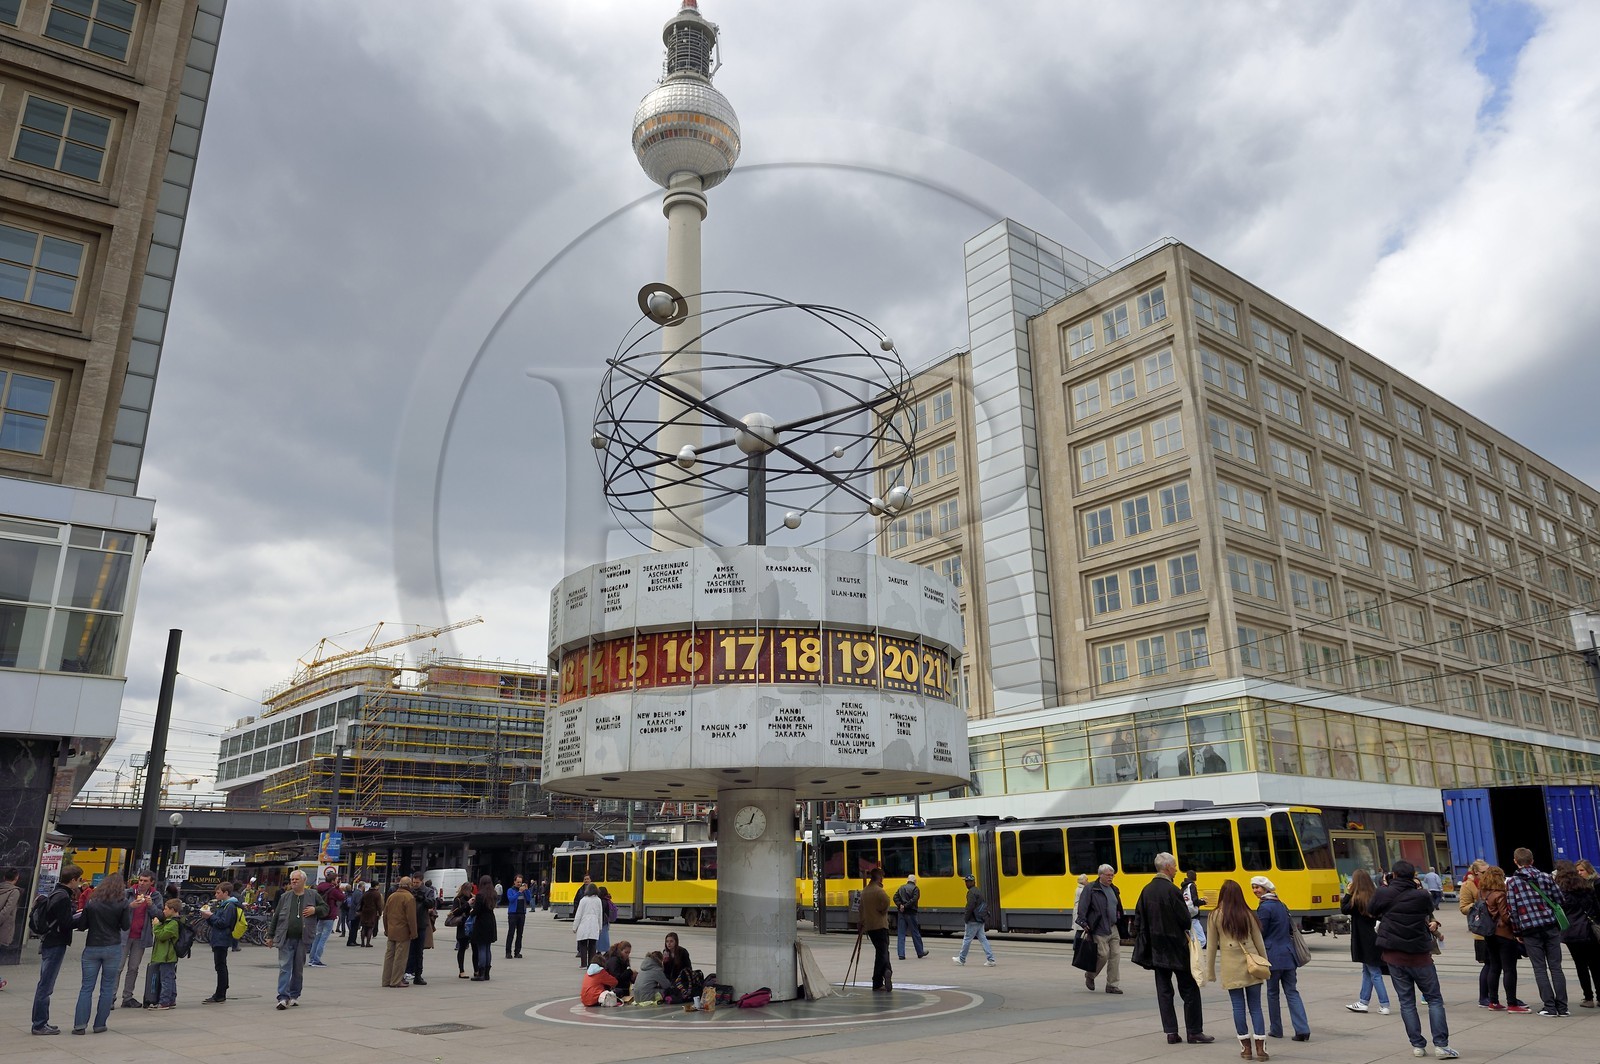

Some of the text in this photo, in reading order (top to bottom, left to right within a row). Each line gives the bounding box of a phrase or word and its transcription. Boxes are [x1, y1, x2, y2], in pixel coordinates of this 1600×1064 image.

[642, 561, 689, 572] JEKATERINBURG
[766, 565, 812, 573] KRASNOJARSK
[648, 569, 683, 578] ASCHGABAT
[651, 576, 679, 585] BISCHKEK
[836, 576, 861, 584] IRKUTSK
[888, 576, 908, 586] JAKUTSK
[647, 583, 683, 592] DUSCHANBE
[831, 590, 867, 599] ULAN-BATOR
[581, 650, 604, 687] 14
[616, 643, 648, 680] 15
[662, 638, 704, 674] 16
[720, 636, 766, 670] 17
[781, 637, 821, 672] 18
[838, 640, 876, 675] 19
[884, 646, 919, 682] 20
[924, 653, 942, 688] 21
[842, 702, 862, 710] PEKING
[638, 712, 650, 720] NEW
[646, 718, 676, 726] KARACHI
[596, 722, 621, 732] MAURITIUS
[640, 726, 668, 734] COLOMBO
[836, 732, 870, 740] HONGKONG
[896, 728, 912, 736] SEOUL
[852, 740, 876, 748] LUMPUR
